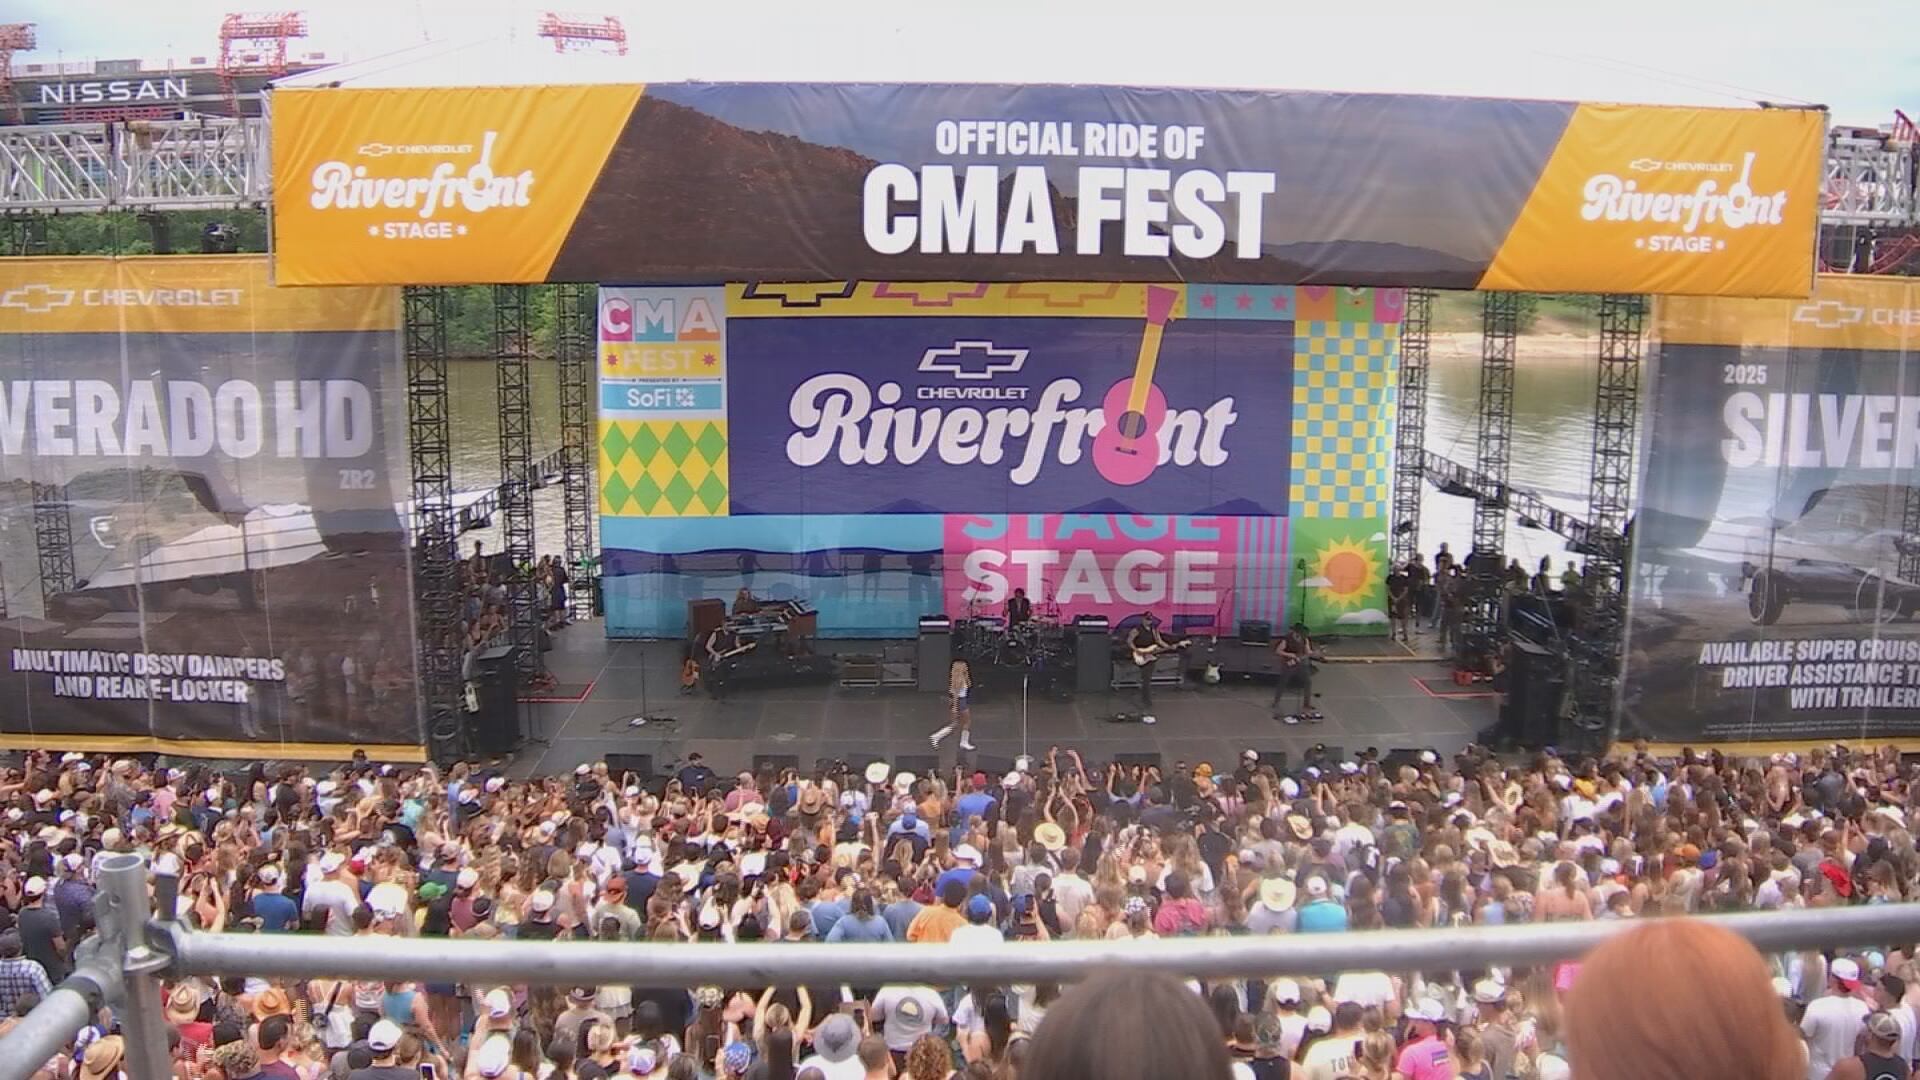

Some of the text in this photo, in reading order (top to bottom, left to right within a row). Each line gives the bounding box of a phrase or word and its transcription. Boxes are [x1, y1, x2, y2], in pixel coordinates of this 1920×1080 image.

[41, 79, 188, 104] NISSAN
[396, 144, 473, 154] CHEVROLET
[935, 120, 1205, 160] OFFICIAL RIDE OF
[1664, 162, 1734, 172] CHEVROLET
[311, 160, 535, 218] Riverfront
[863, 163, 1276, 259] CMA FEST
[1580, 174, 1787, 233] Riverfront
[384, 222, 453, 239] STAGE
[1649, 237, 1713, 252] STAGE
[83, 288, 244, 307] CHEVROLET
[602, 297, 720, 336] CMA
[622, 349, 696, 371] FEST
[1723, 364, 1768, 384] 2025
[627, 388, 671, 408] SoFi
[917, 386, 1029, 400] CHEVROLET
[274, 378, 374, 459] HD
[786, 373, 1238, 485] Riverfront
[339, 470, 376, 489] ZR2
[961, 549, 1219, 605] STAGE
[1699, 639, 1920, 664] AVAILABLE SUPER CRUIS
[12, 648, 130, 673] MULTIMATIC
[187, 656, 286, 682] DAMPERS
[1723, 665, 1787, 688] DRIVER
[1790, 663, 1903, 686] ASSISTANCE
[55, 675, 249, 703] AND REAR E-LOCKER
[1791, 686, 1920, 709] WITH TRAILER
